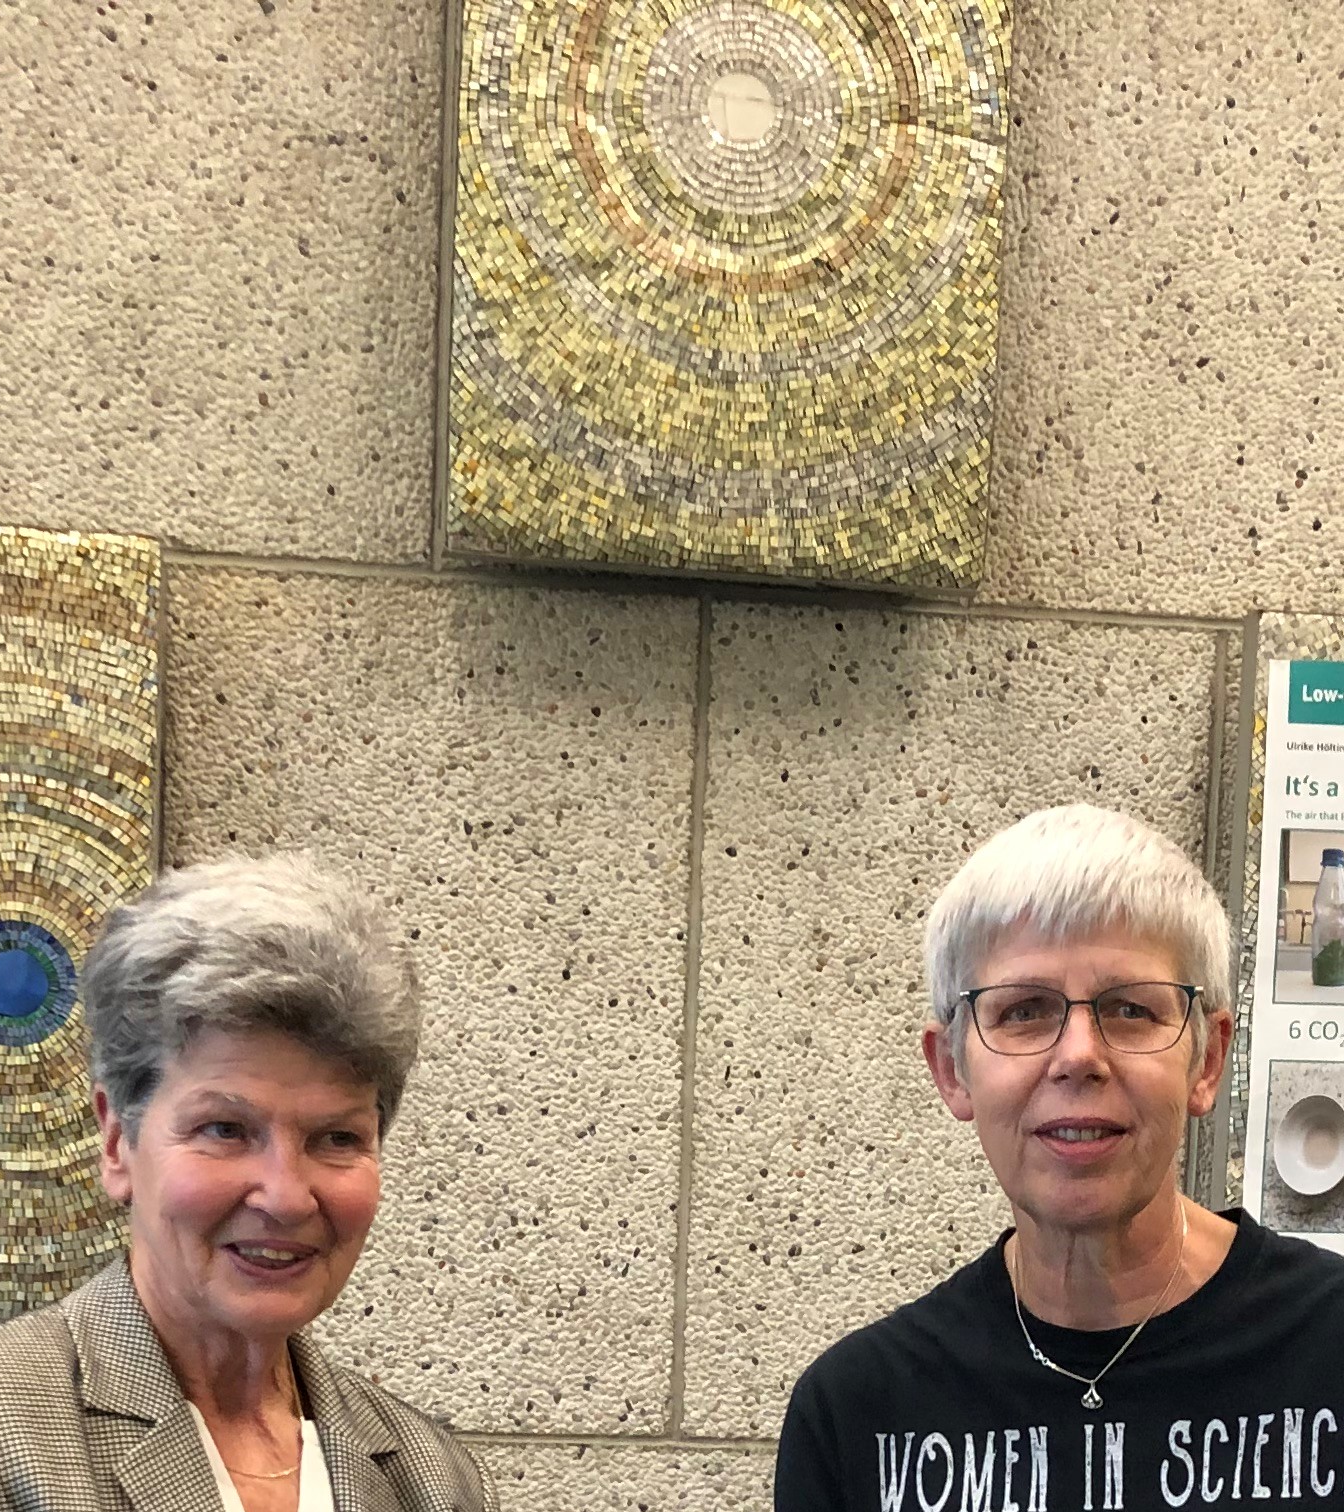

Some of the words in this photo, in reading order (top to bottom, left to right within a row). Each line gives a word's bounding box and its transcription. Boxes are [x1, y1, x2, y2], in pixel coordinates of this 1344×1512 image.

[1286, 741, 1314, 752] Ulrike
[1326, 781, 1339, 797] a
[1285, 810, 1303, 820] The
[1304, 811, 1318, 821] air
[1289, 1020, 1302, 1040] 6
[1082, 1421, 1126, 1511] IN
